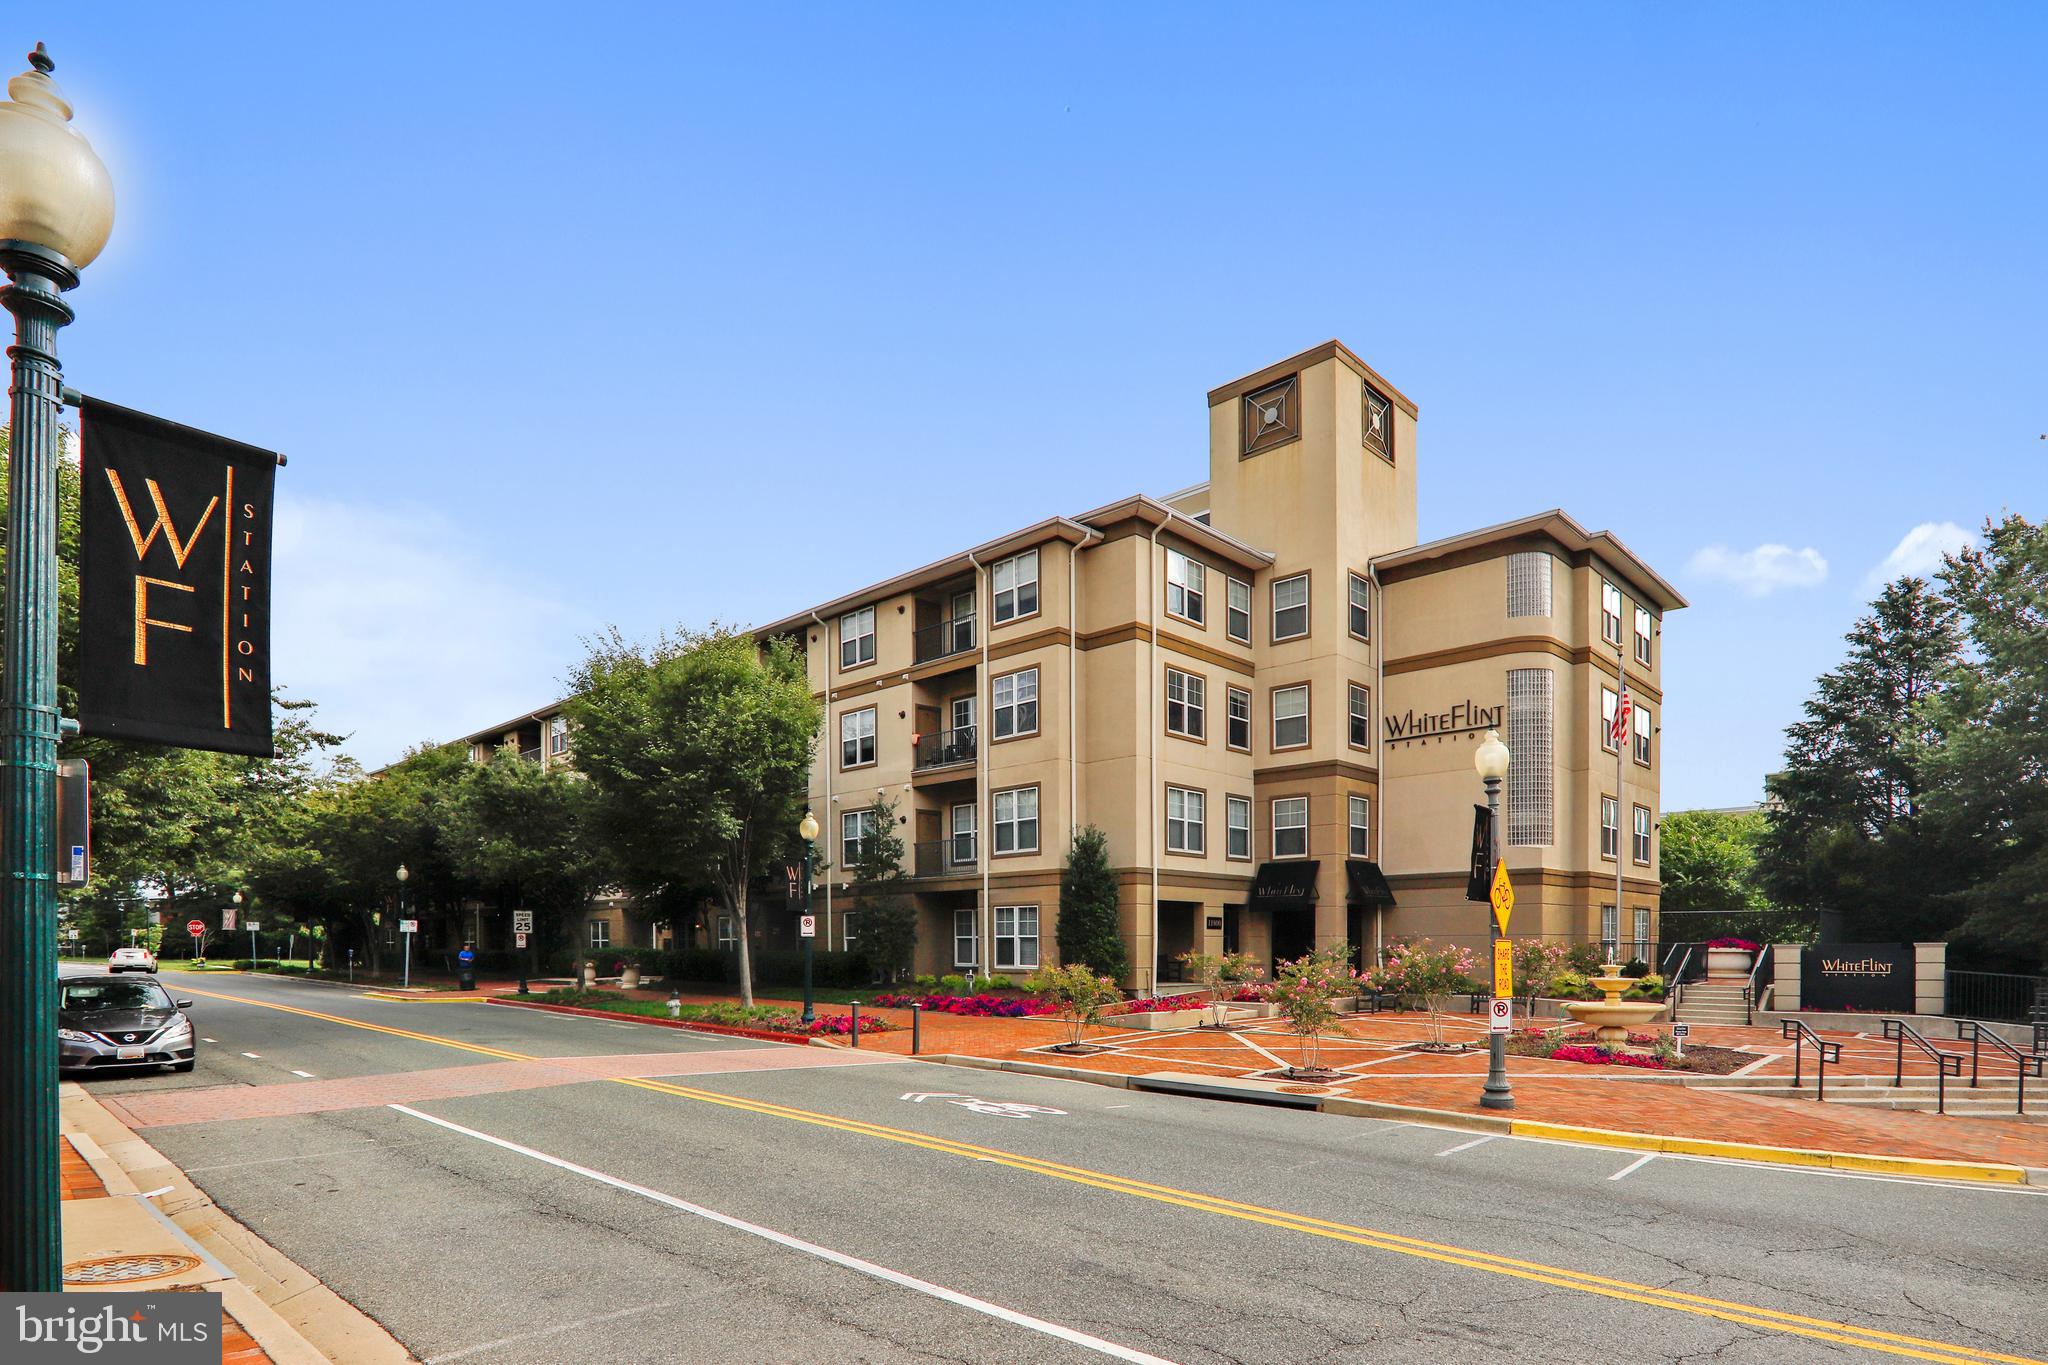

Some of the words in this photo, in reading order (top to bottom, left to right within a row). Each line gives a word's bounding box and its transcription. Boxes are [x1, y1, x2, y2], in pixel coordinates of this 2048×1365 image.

[237, 503, 254, 682] STATION
[1391, 732, 1475, 751] STATIO
[515, 922, 531, 931] 25
[1497, 948, 1510, 960] SHARE
[1499, 963, 1508, 975] THE
[1499, 978, 1509, 990] ROAD
